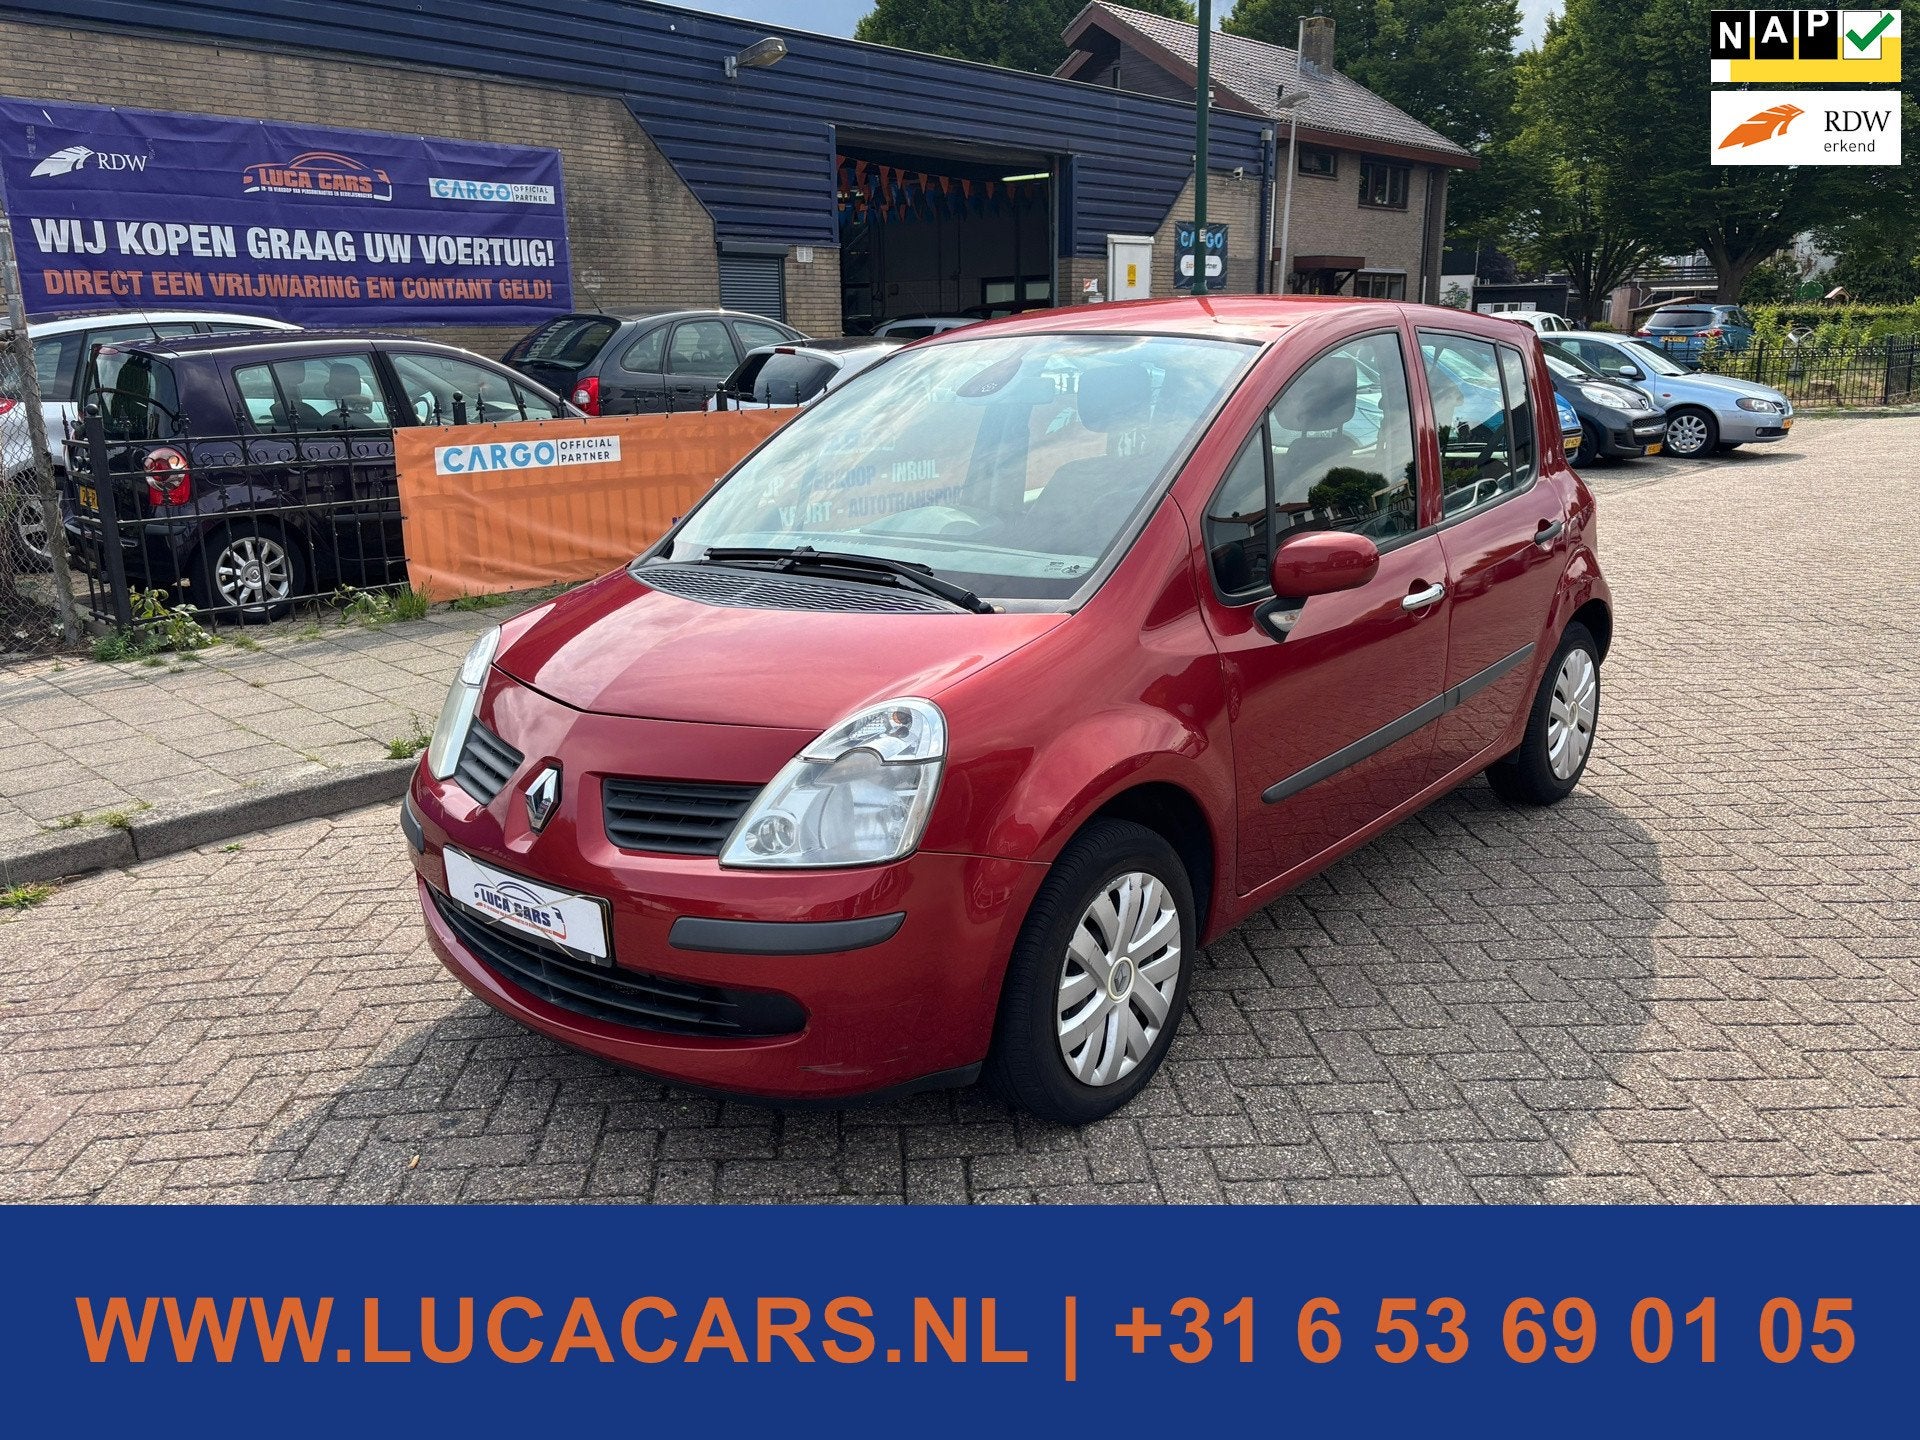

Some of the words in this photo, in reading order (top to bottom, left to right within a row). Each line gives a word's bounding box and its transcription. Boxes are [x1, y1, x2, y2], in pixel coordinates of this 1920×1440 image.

[97, 152, 147, 171] RDW
[259, 168, 312, 188] LUCA
[318, 173, 373, 193] CARS
[435, 179, 511, 201] CARGO
[513, 185, 549, 194] OFFICIAL
[515, 194, 548, 202] PARTNER
[30, 218, 107, 254] WIJ
[116, 221, 237, 258] KOPEN
[247, 226, 356, 262] GRAAG
[363, 233, 411, 264] UW
[418, 235, 555, 267] VOERTUIG!
[43, 269, 143, 295] DIRECT
[151, 271, 203, 297] EEN
[208, 272, 360, 299] VRIJWARING
[366, 276, 395, 299] EN
[402, 277, 492, 300] CONTANT
[500, 278, 552, 300] GELD!
[560, 438, 612, 450] OFFICIAL
[443, 441, 555, 472] CARGO
[561, 451, 610, 463] PARTNER
[892, 459, 940, 482] INRUIL
[481, 888, 511, 913] LUCA
[513, 902, 551, 927] CARS
